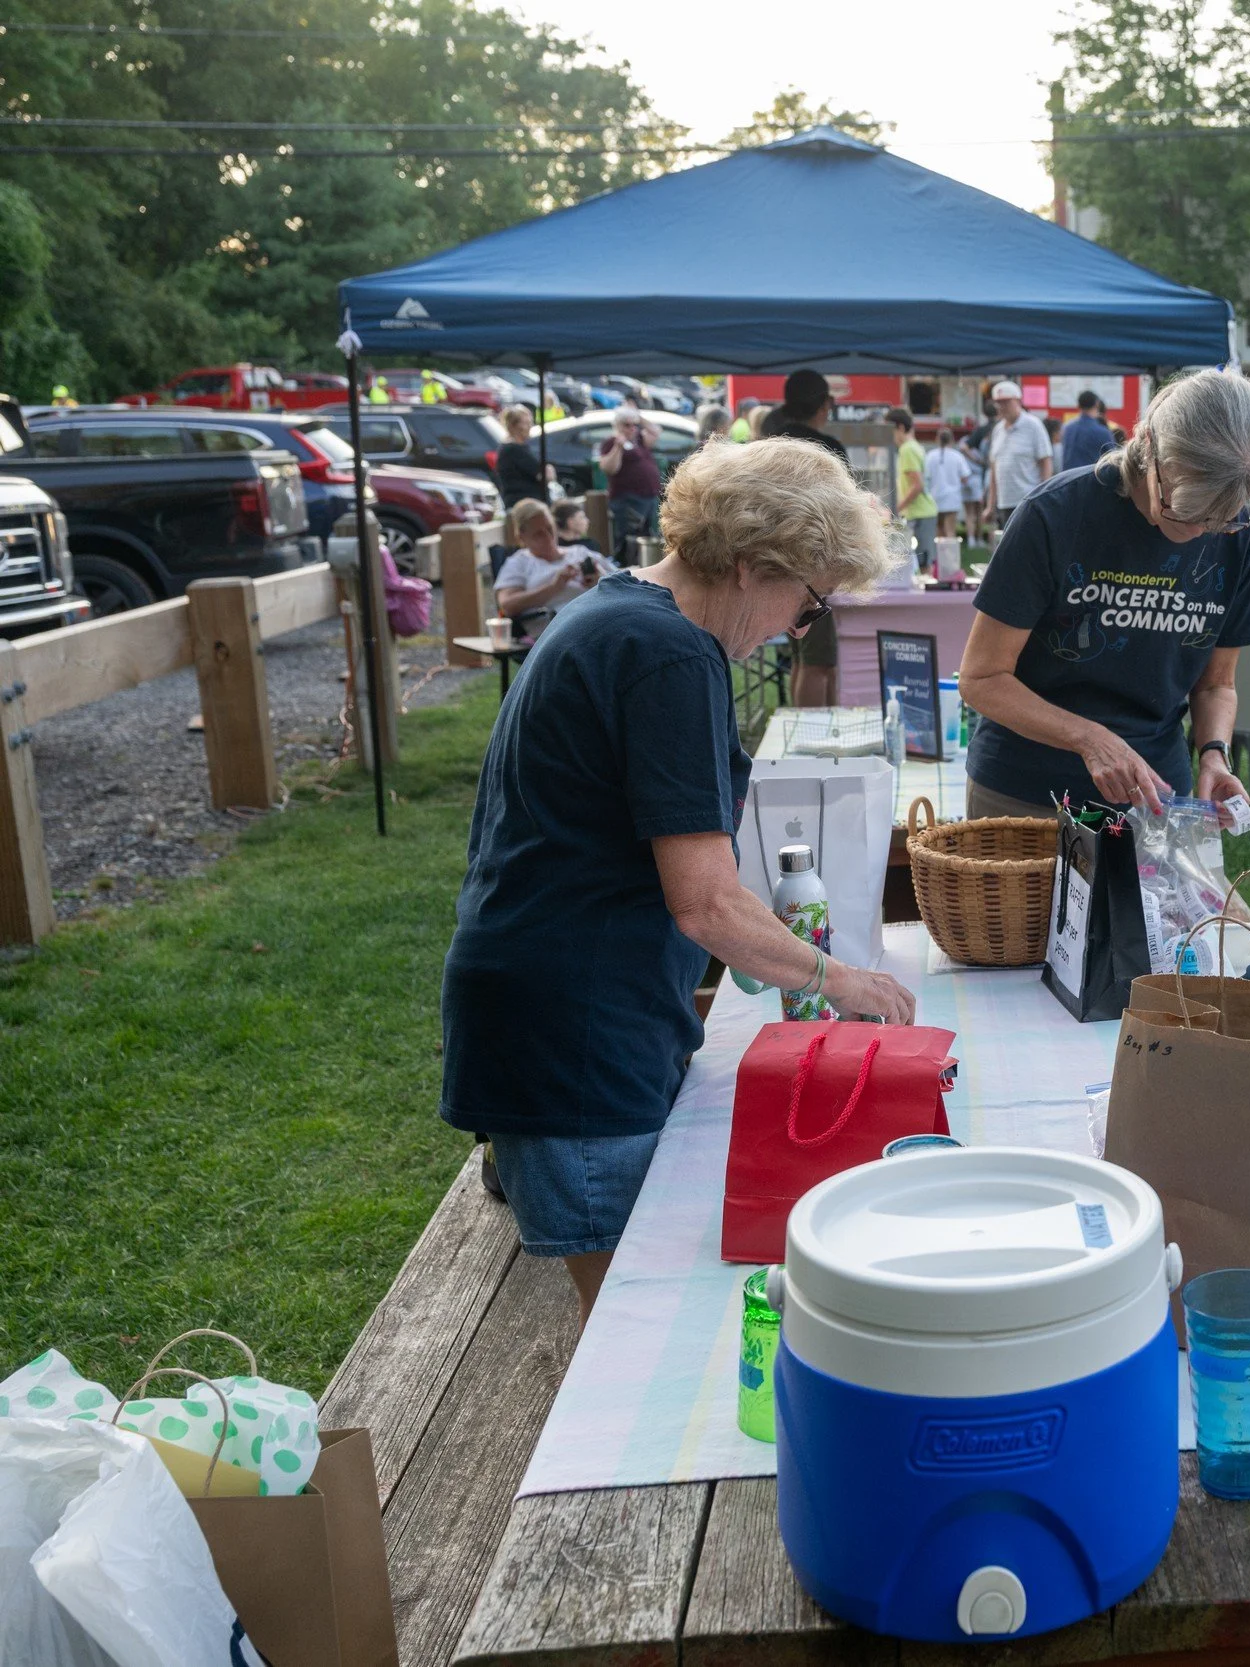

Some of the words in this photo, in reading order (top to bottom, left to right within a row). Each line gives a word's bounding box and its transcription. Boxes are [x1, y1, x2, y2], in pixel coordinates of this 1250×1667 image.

[1092, 570, 1177, 589] Londonderry
[1067, 584, 1187, 611] CONCERTS
[1187, 601, 1202, 612] on
[1205, 602, 1225, 614] the
[1101, 609, 1206, 633] COMMON
[883, 641, 917, 652] CONCERTS
[895, 651, 925, 663] COMMON
[1148, 934, 1159, 957] TICKET
[932, 1426, 1024, 1453] Coleman
